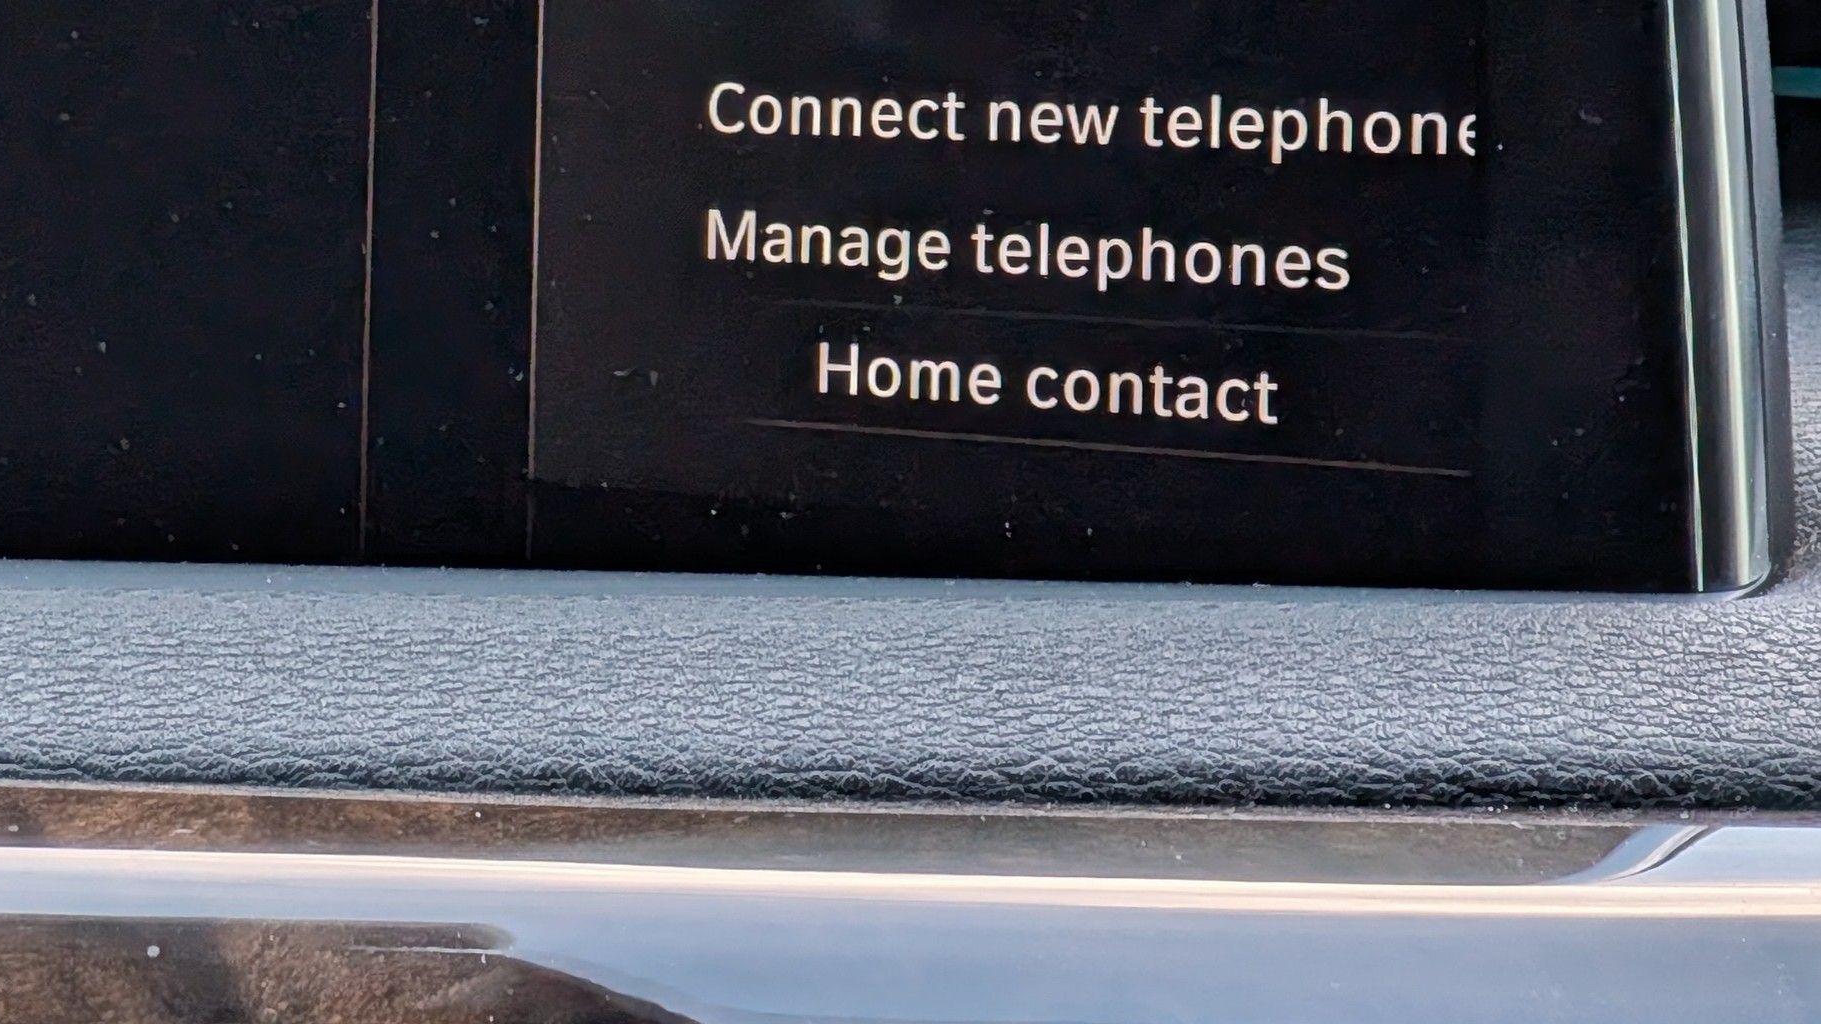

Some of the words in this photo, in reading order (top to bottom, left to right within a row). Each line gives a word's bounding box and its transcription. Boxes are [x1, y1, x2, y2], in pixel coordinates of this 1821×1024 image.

[708, 81, 966, 141] Connect
[988, 100, 1120, 146] new
[707, 208, 951, 282] Manage
[970, 222, 1350, 292] telephones
[818, 341, 1002, 405] Home
[1026, 365, 1279, 425] contact
